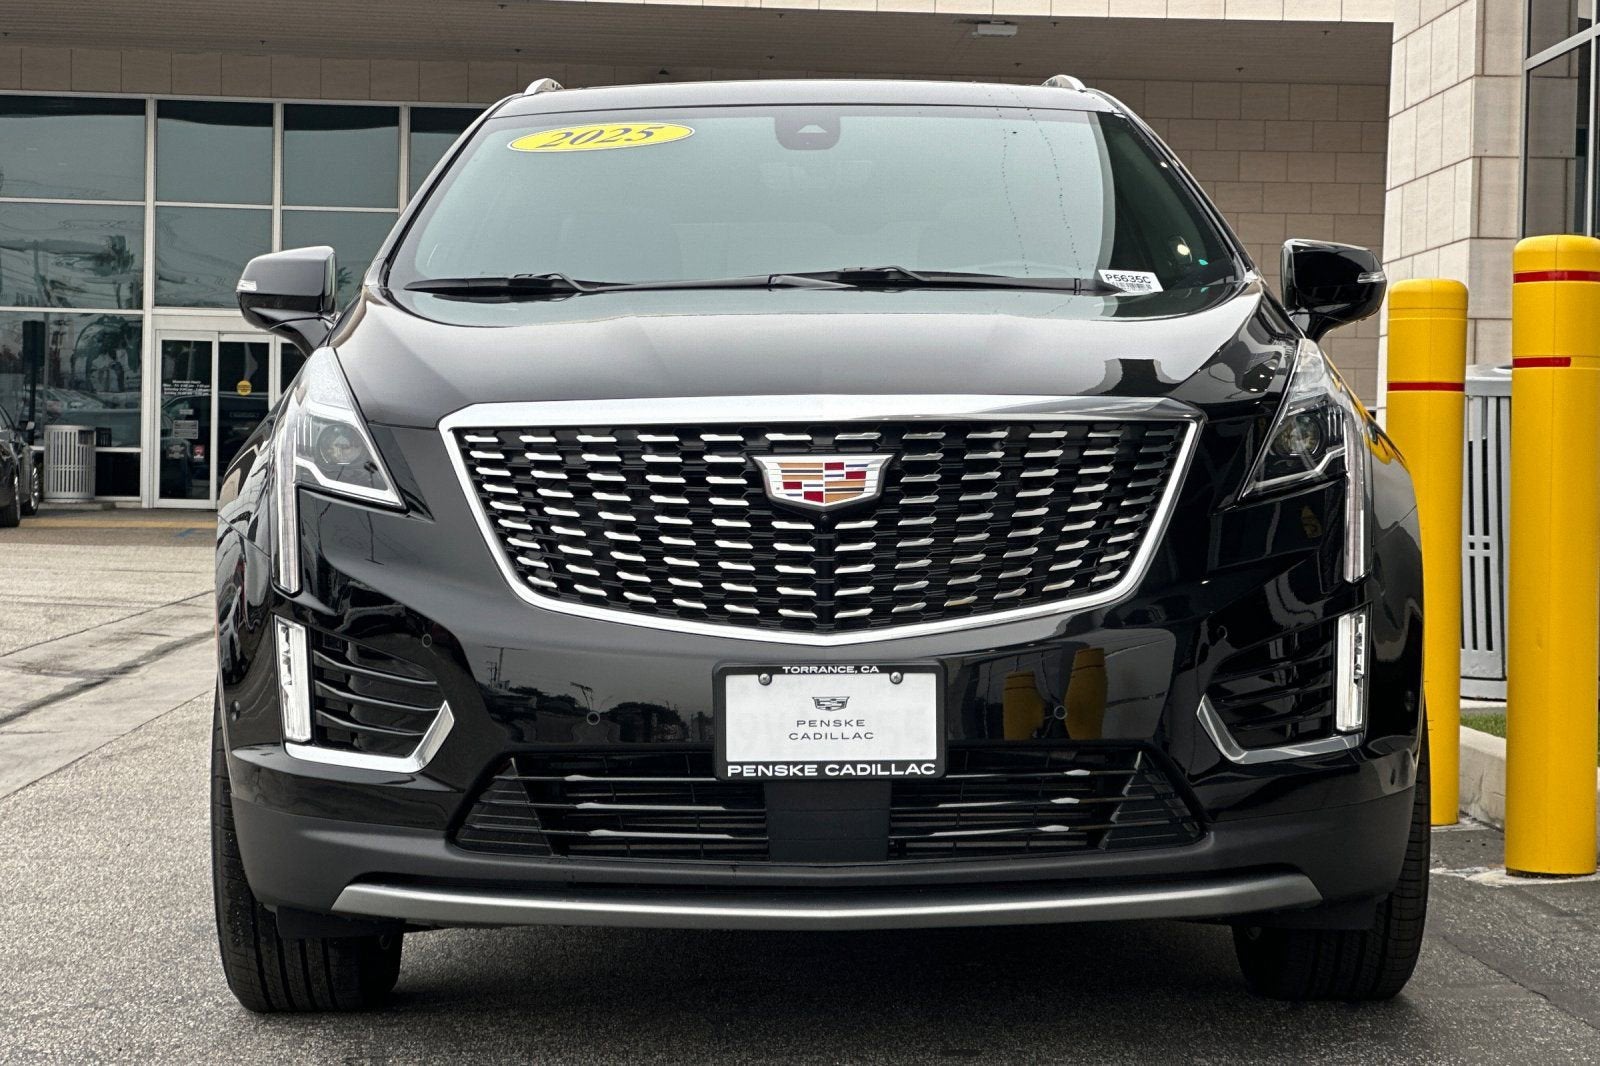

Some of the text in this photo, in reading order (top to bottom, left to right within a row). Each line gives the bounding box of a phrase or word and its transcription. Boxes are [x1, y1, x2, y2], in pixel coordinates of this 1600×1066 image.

[536, 126, 664, 148] 2025
[1105, 273, 1151, 284] P5635C
[782, 665, 880, 674] TORRANCE, CA
[796, 719, 866, 728] PENSKE
[788, 731, 875, 741] CADILLAC
[727, 763, 936, 777] PENSKE CADILLAC
